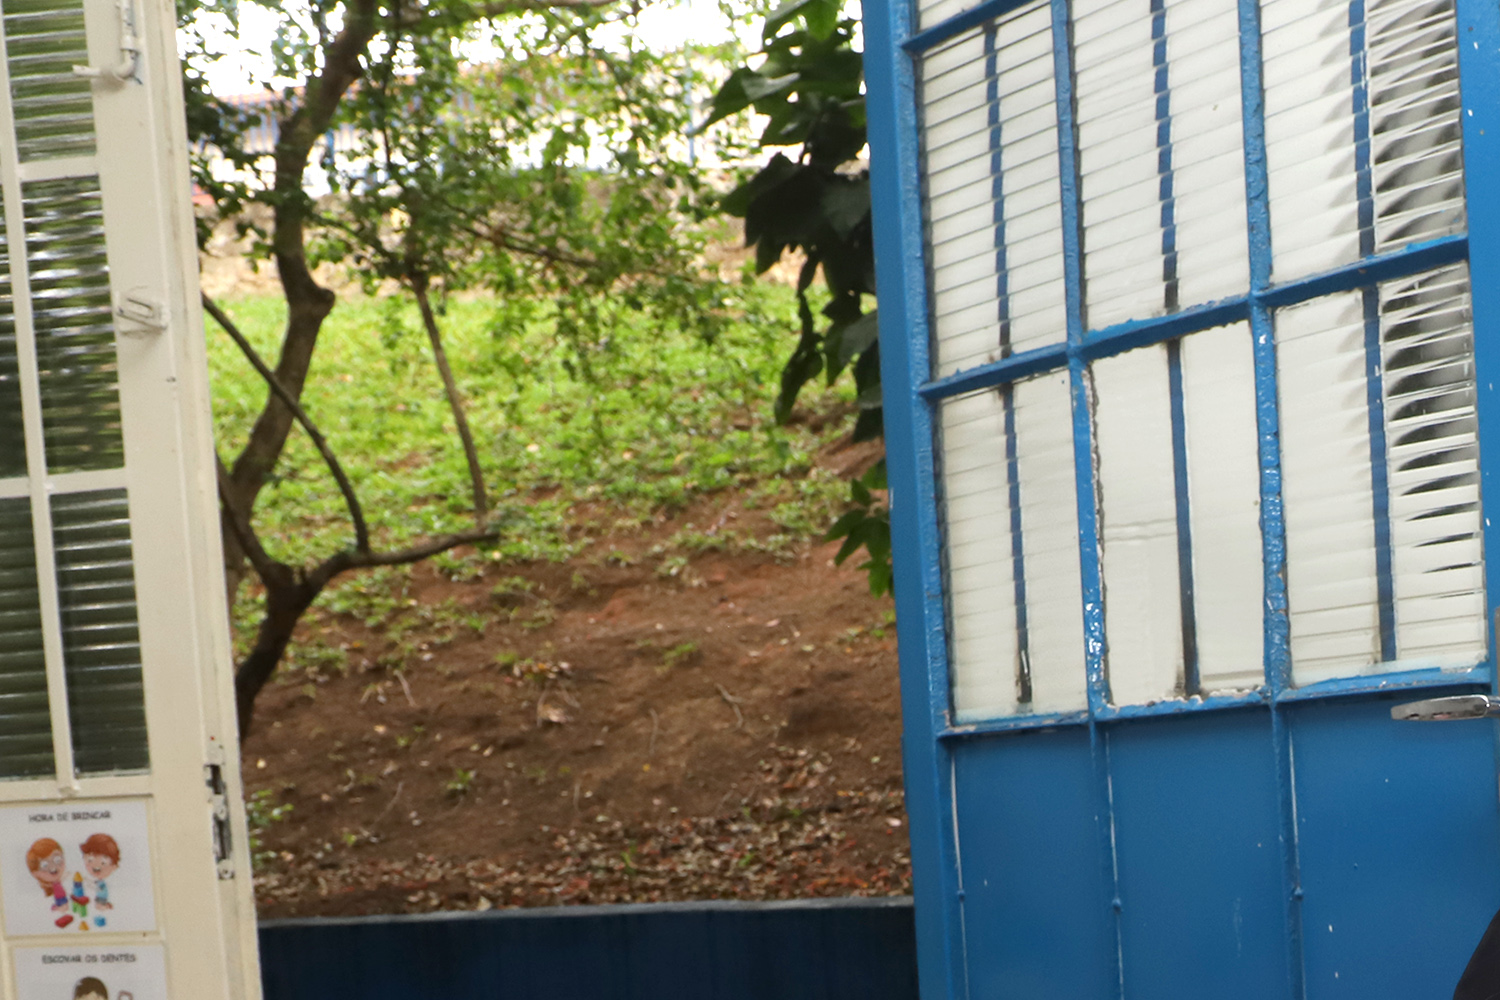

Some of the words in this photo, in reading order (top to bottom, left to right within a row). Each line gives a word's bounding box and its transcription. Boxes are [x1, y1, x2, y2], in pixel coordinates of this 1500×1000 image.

[28, 813, 53, 823] HORA
[56, 812, 68, 822] DE
[71, 810, 111, 820] BRINCAR
[42, 954, 81, 963] ESCOVAR
[85, 954, 98, 962] OS
[100, 953, 136, 962] DENTES
